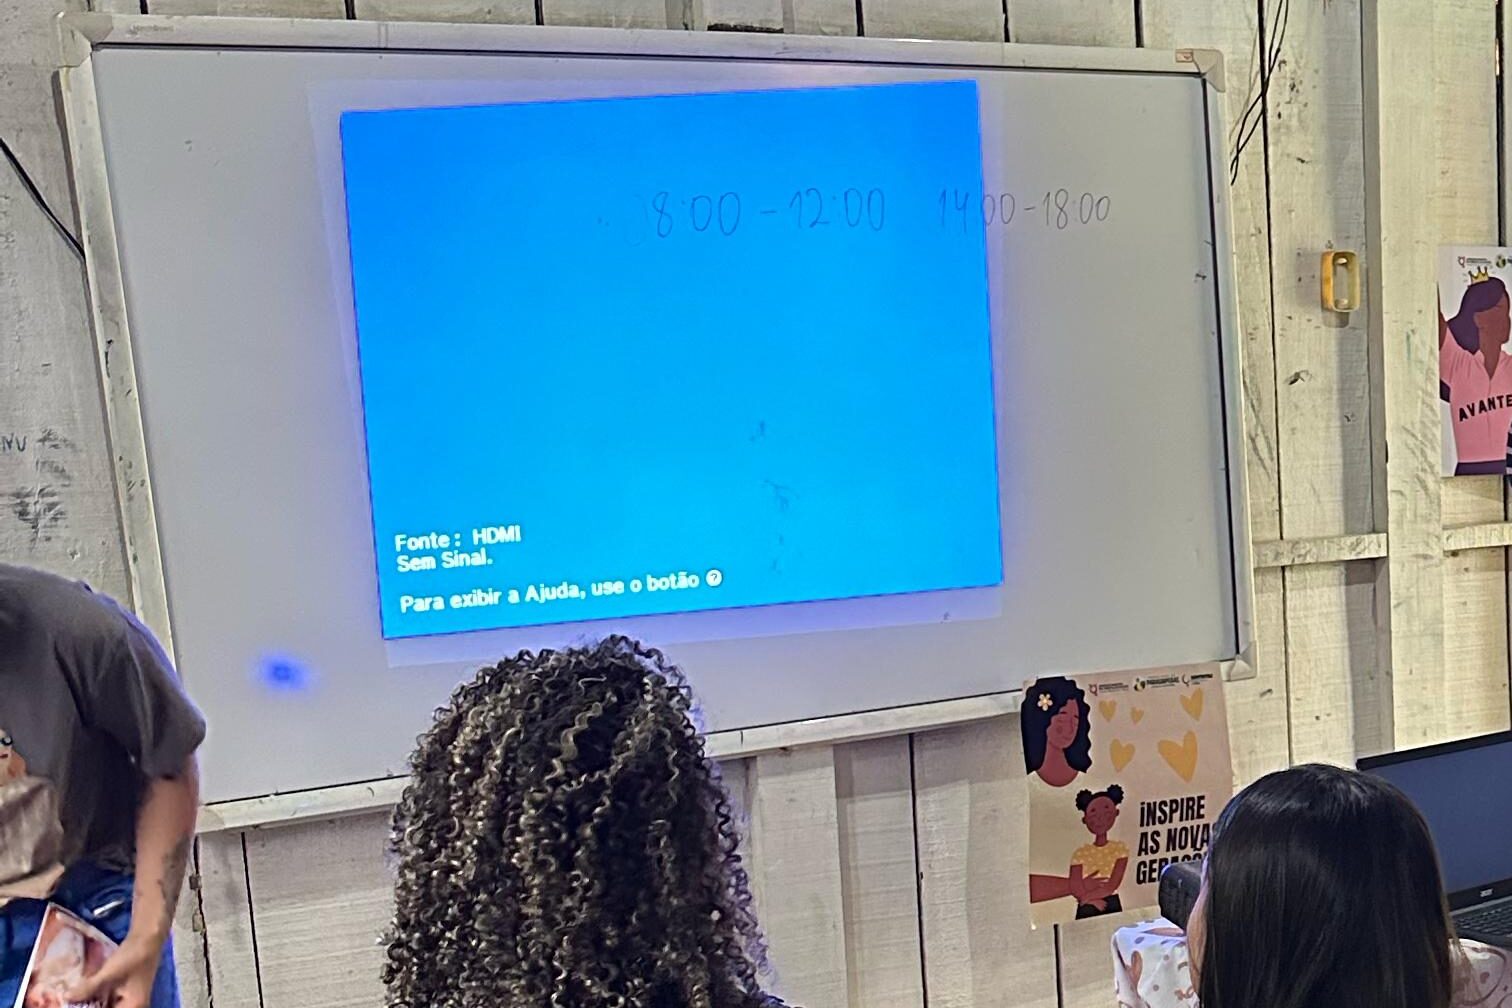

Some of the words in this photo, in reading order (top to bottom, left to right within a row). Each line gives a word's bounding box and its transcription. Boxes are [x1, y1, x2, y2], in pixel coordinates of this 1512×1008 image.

[472, 525, 521, 546] HDMI
[397, 555, 436, 573] Sem
[441, 548, 493, 569] Sinal.
[400, 595, 445, 613] Para
[450, 588, 501, 609] exibir
[507, 590, 520, 604] a
[525, 580, 586, 605] Ajuda,
[591, 580, 625, 597] use
[629, 579, 642, 593] o
[646, 571, 700, 592] botão
[1137, 830, 1161, 857] AS
[1166, 822, 1216, 853] NOVA
